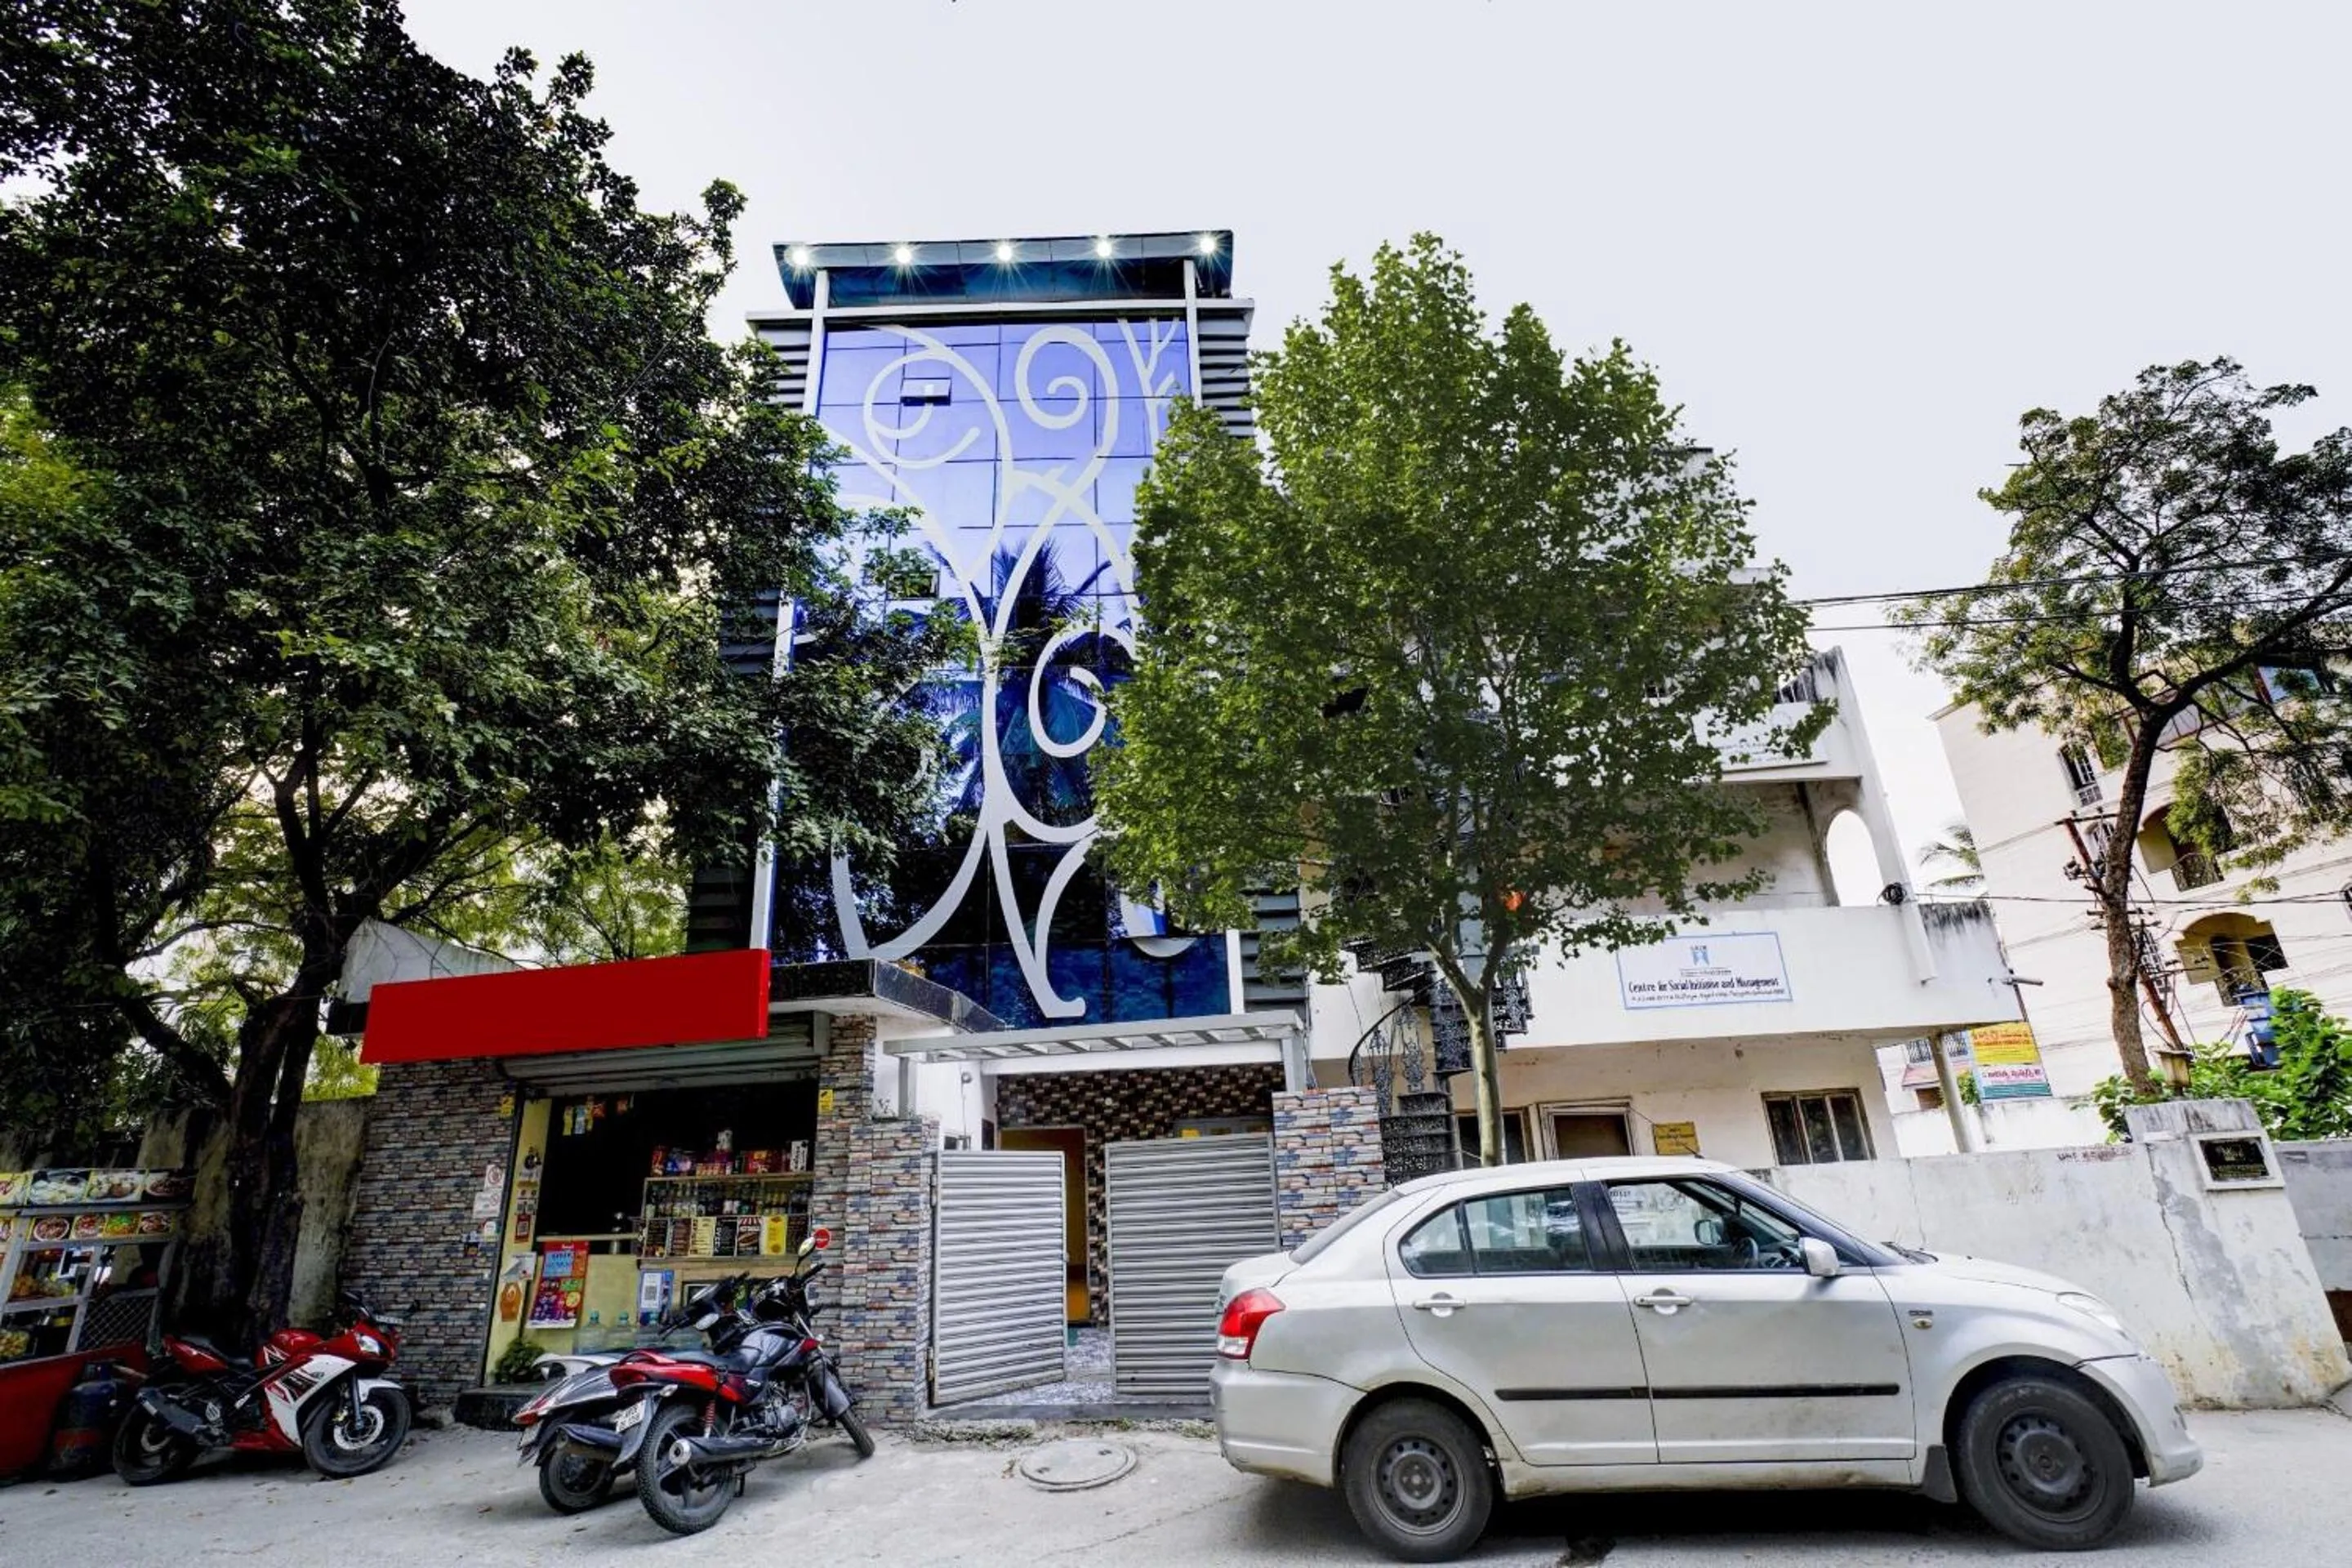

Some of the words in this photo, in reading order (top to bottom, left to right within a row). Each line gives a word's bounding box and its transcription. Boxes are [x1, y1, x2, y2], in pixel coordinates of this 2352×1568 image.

[1628, 981, 1655, 993] Centre
[1721, 977, 1735, 988] and
[1735, 976, 1779, 990] Management
